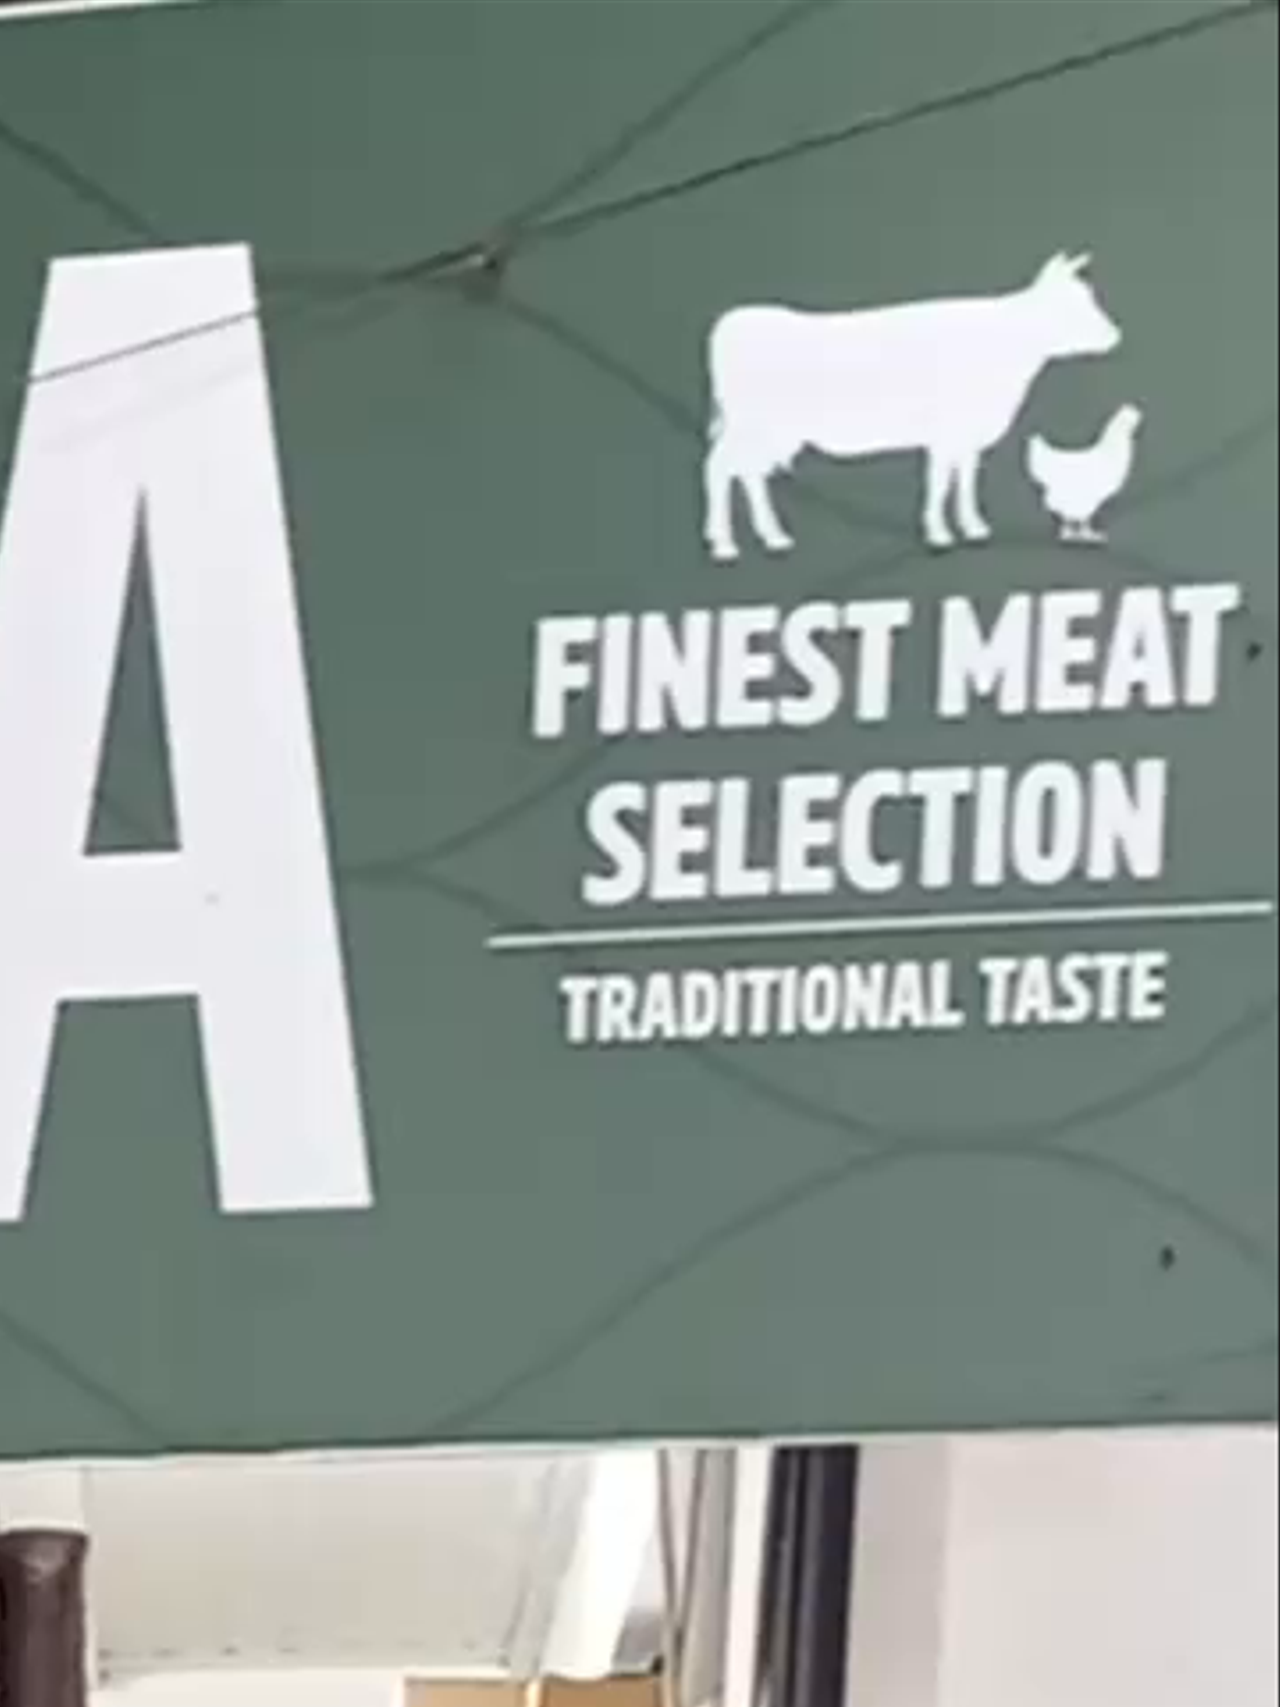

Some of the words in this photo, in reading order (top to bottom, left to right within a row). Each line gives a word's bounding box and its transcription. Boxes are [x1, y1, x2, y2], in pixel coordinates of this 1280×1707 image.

[532, 598, 911, 738] FINEST
[937, 583, 1240, 717] MEAT
[582, 758, 1168, 905] SELECTION
[558, 960, 965, 1043] TRADITIONAL
[978, 951, 1169, 1025] TASTE
